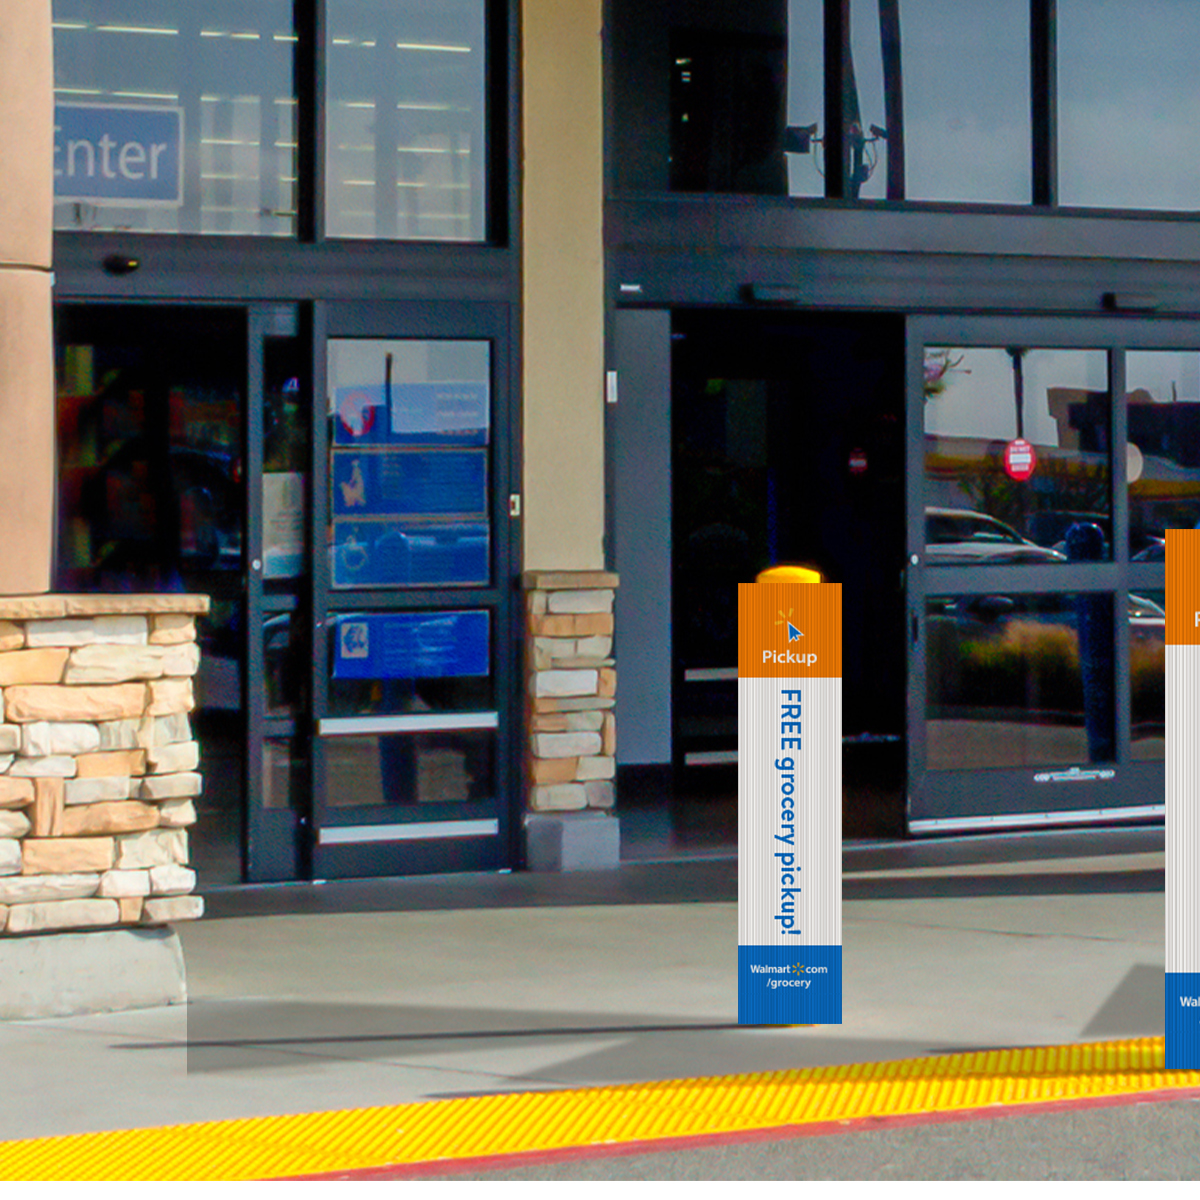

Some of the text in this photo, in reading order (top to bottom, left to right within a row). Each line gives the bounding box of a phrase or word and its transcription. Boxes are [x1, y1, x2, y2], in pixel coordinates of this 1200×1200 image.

[762, 649, 818, 667] Pickup
[773, 689, 802, 935] FREE grocery pickup!
[750, 964, 828, 974] Walmart com
[766, 978, 812, 990] /grocery
